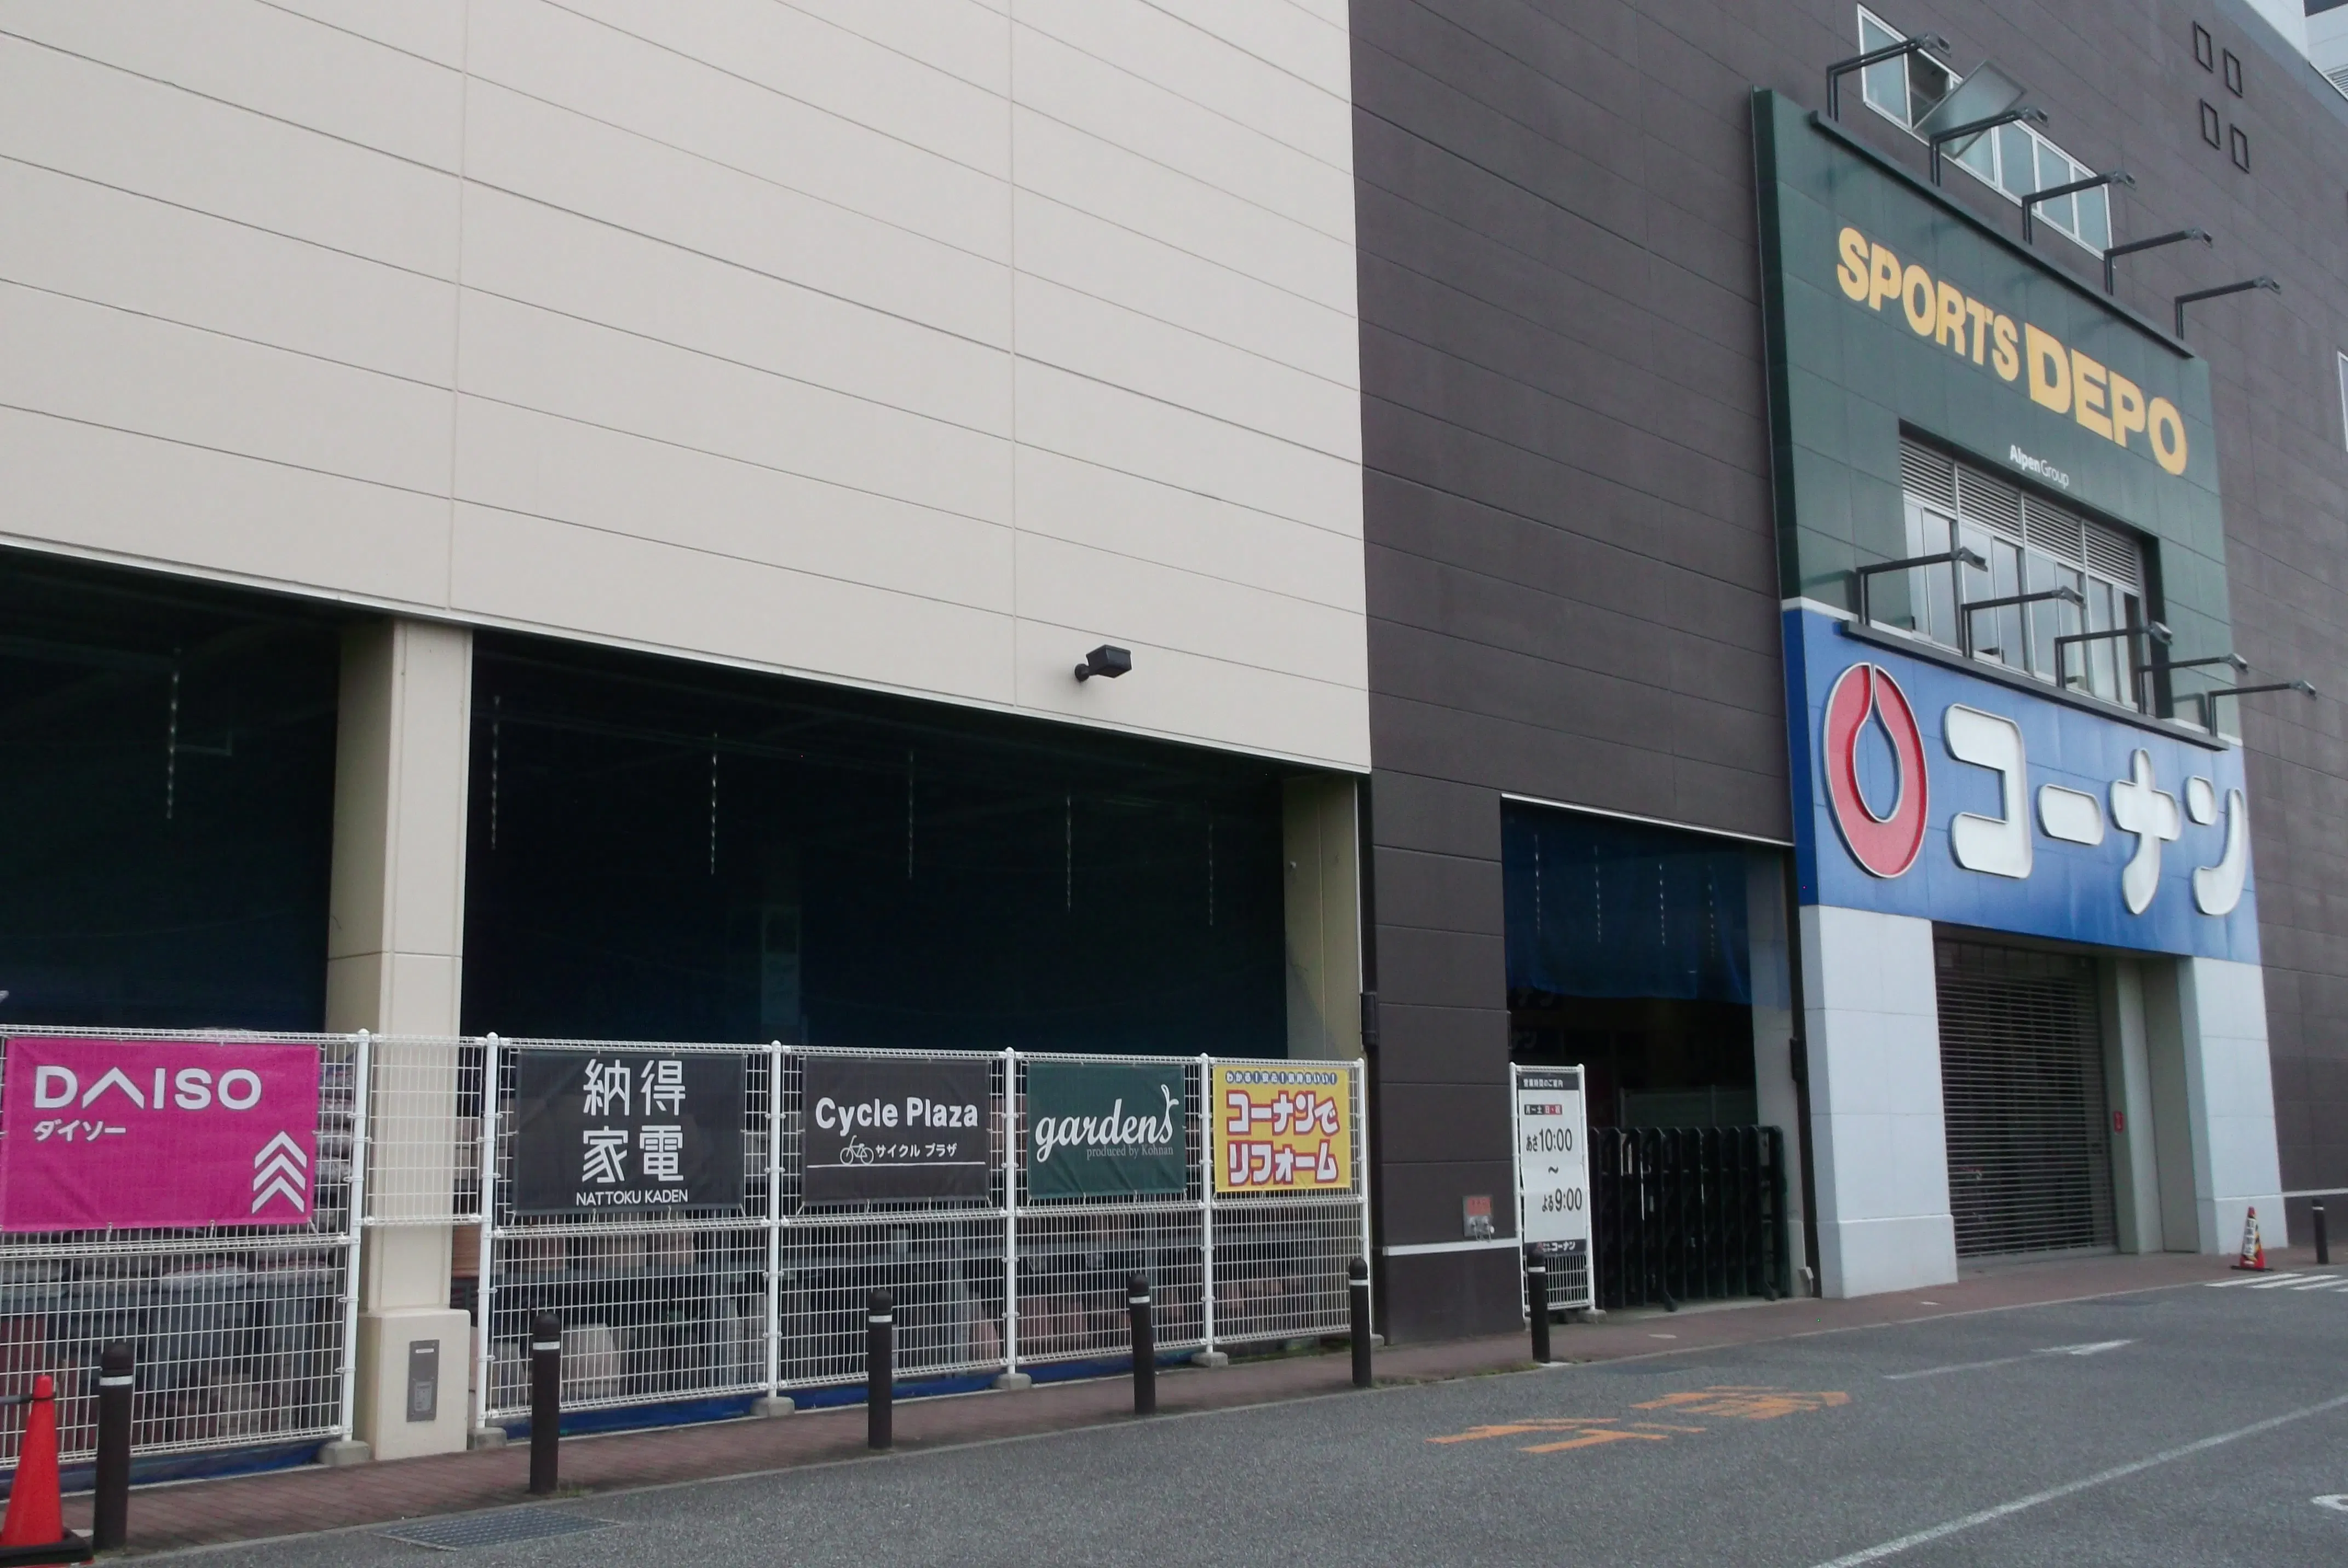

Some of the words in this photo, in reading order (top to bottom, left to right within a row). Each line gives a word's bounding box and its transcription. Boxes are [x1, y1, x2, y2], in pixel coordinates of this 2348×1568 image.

[1837, 227, 2019, 382] SPORTS
[2025, 322, 2188, 475] DEPO
[1944, 702, 2247, 916] コーナン
[33, 1065, 262, 1110] DAISO
[583, 1058, 686, 1116] 納得
[33, 1118, 126, 1142] ダイソー
[815, 1097, 898, 1137] Cycle
[906, 1097, 979, 1128] Plaza
[1035, 1083, 1179, 1163] gardens
[1226, 1089, 1340, 1137] コーナンで
[582, 1125, 684, 1183] 家電
[875, 1144, 921, 1158] サイクル
[925, 1142, 958, 1157] プラザ
[1086, 1144, 1126, 1161] produced
[1128, 1145, 1140, 1160] by
[1141, 1144, 1173, 1156] Kohnan
[1227, 1139, 1339, 1186] リフォーム
[576, 1190, 642, 1206] NATTOKU
[644, 1189, 688, 1203] KADEN
